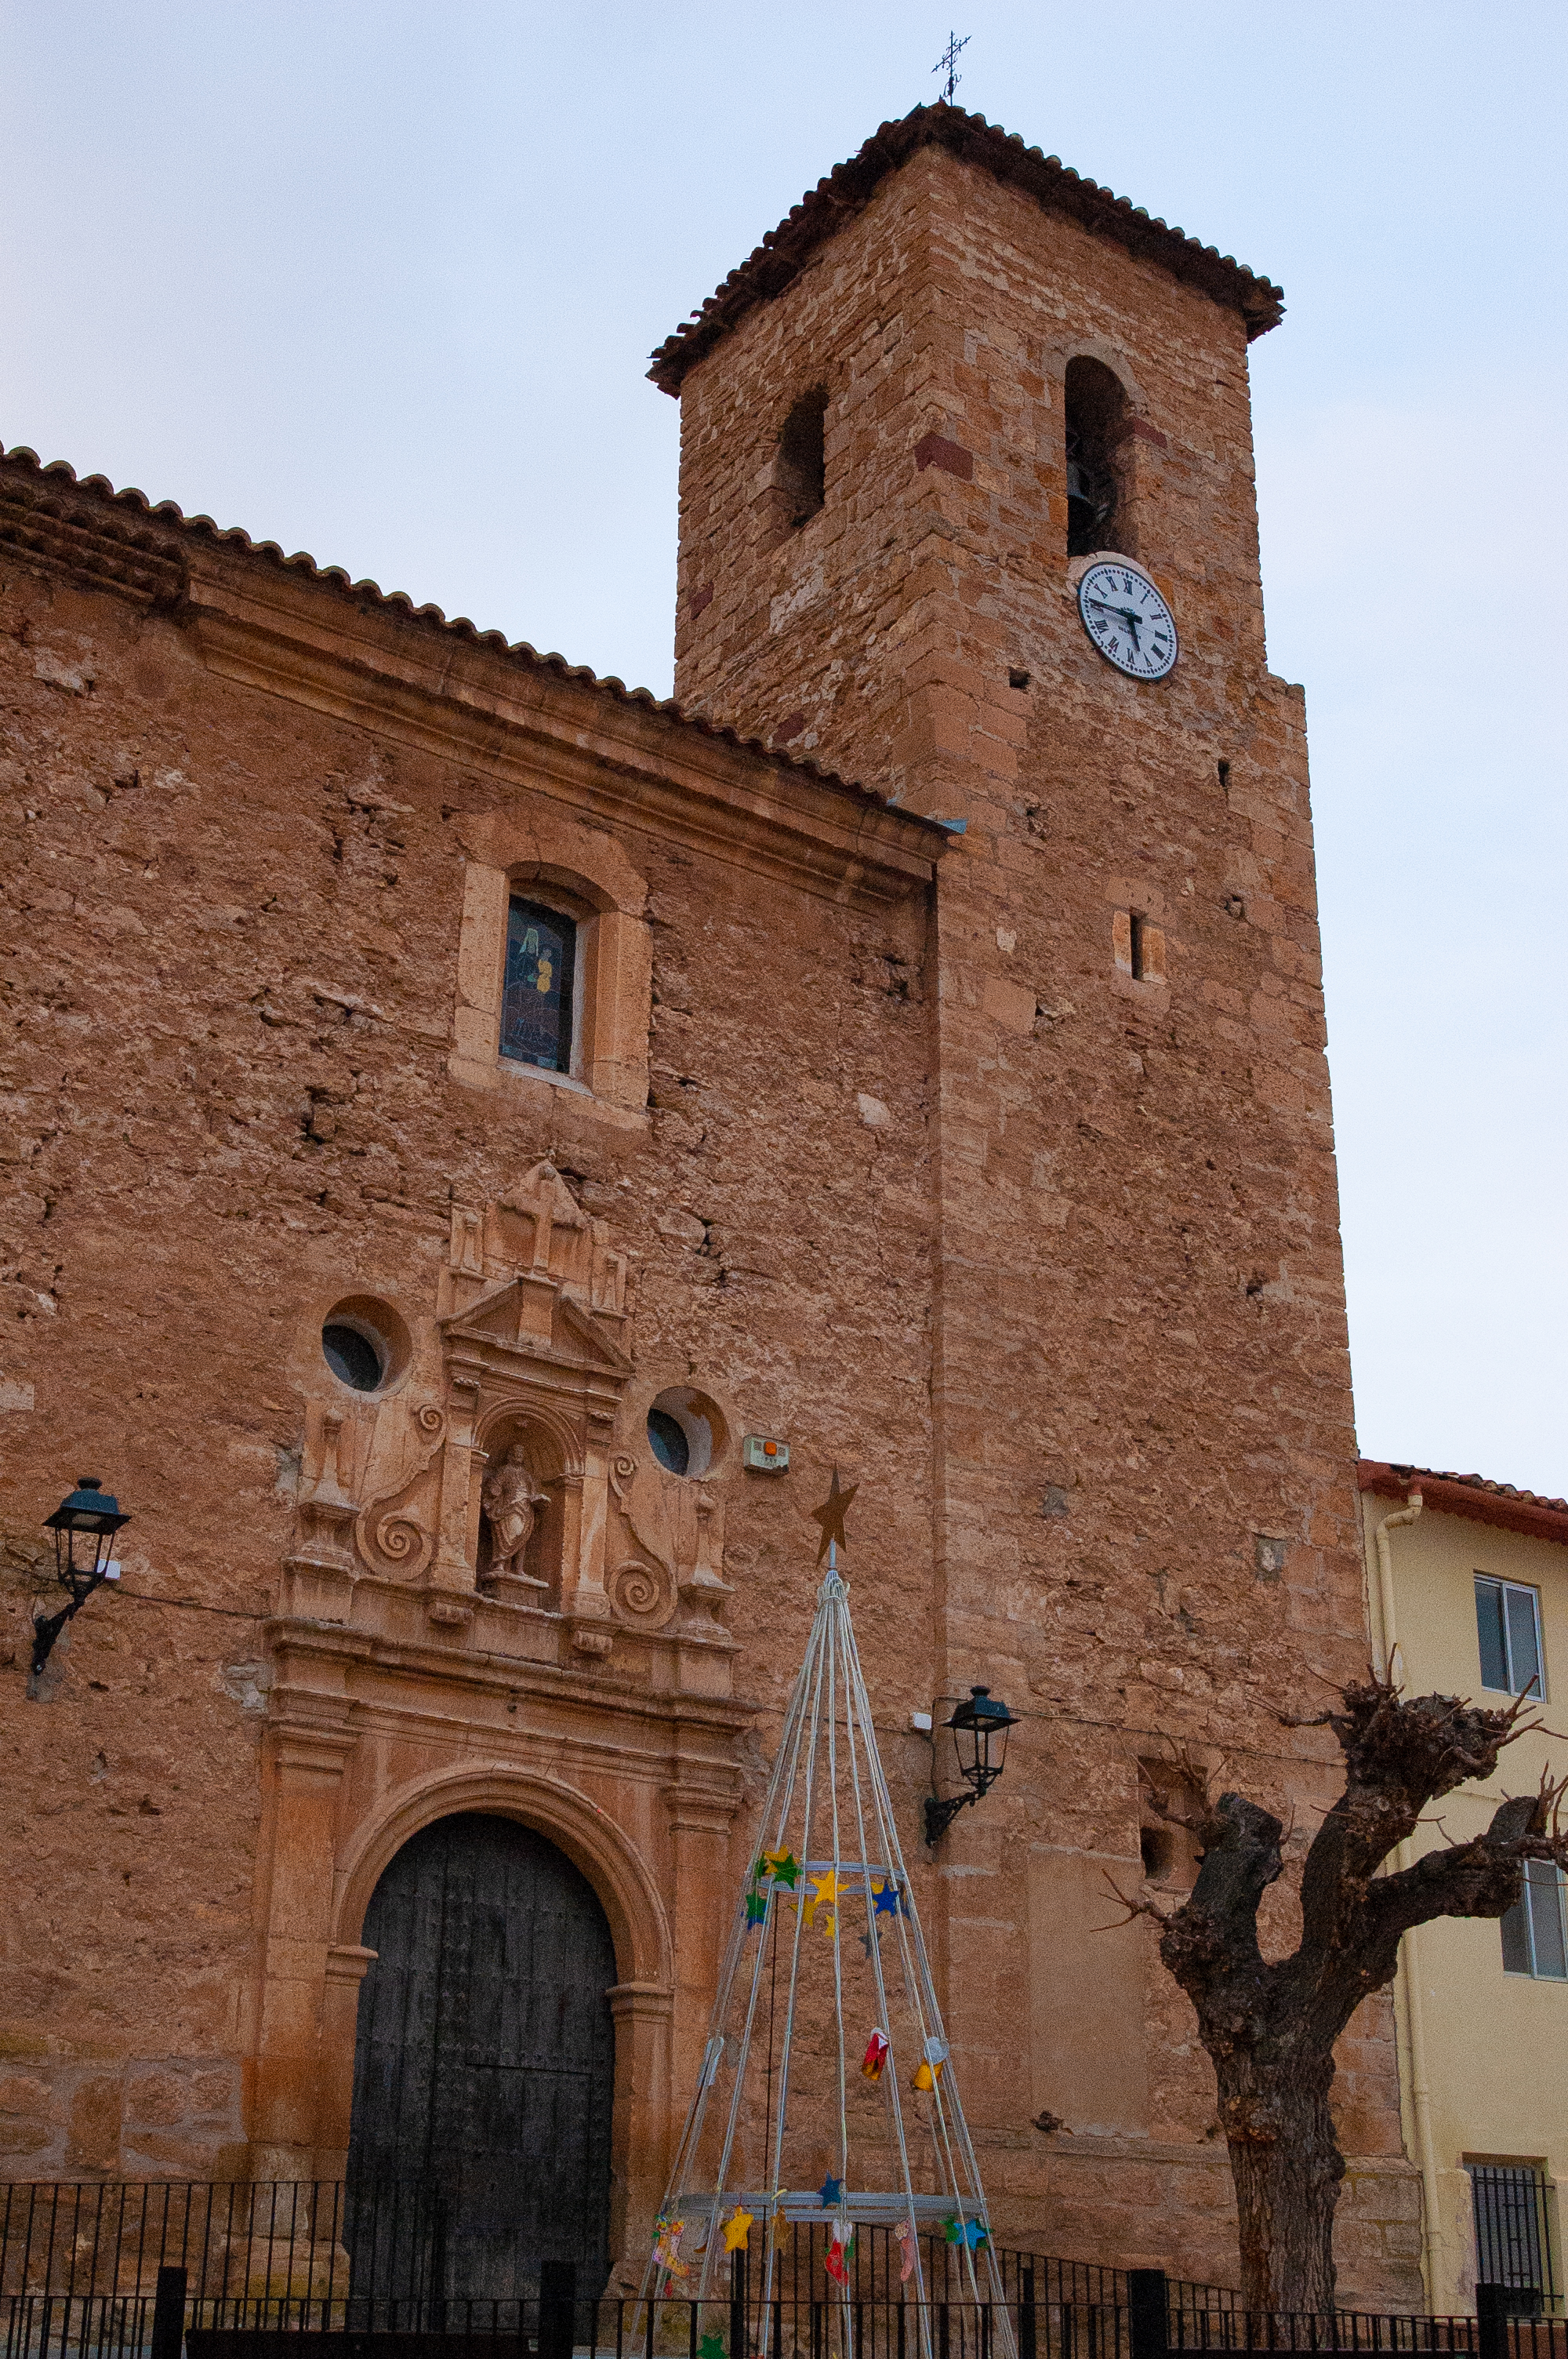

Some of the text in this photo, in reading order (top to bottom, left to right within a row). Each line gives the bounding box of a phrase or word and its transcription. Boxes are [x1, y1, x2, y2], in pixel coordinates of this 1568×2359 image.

[1094, 583, 1108, 599] X
[1123, 578, 1133, 595] XII
[1140, 594, 1148, 605] I
[1094, 619, 1109, 634] VIII
[1108, 635, 1120, 653] VII
[1127, 648, 1135, 665] VI
[1143, 652, 1152, 667] V
